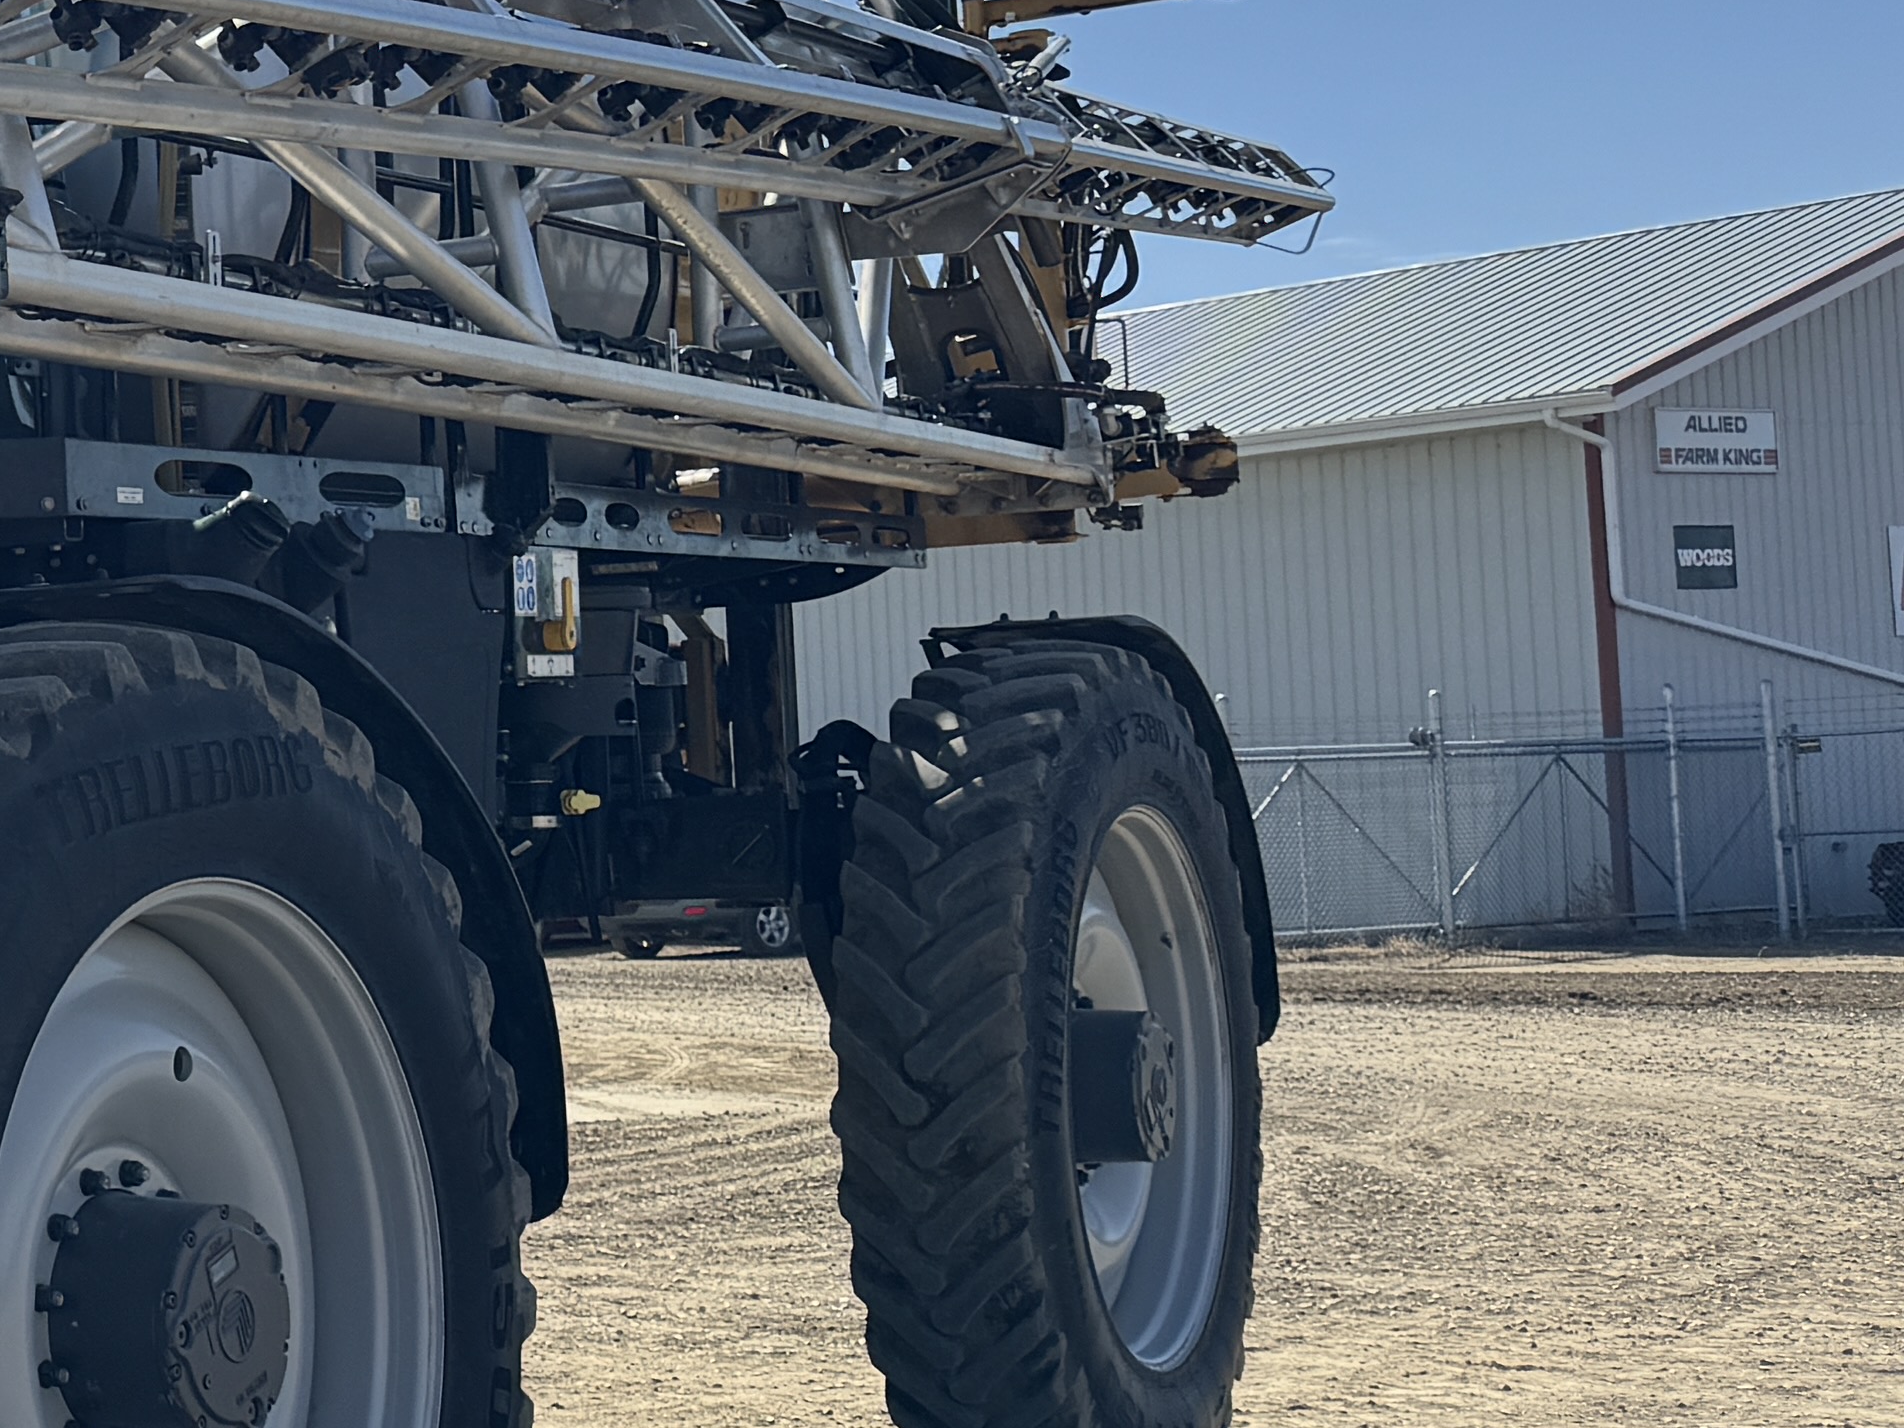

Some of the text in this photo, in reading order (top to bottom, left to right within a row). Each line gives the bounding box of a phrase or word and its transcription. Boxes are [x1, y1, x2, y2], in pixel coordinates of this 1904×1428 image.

[1684, 415, 1748, 435] ALLIED
[1674, 447, 1763, 466] FARM KING
[1677, 547, 1733, 568] WOODS
[32, 732, 314, 847] TRELLEBORG
